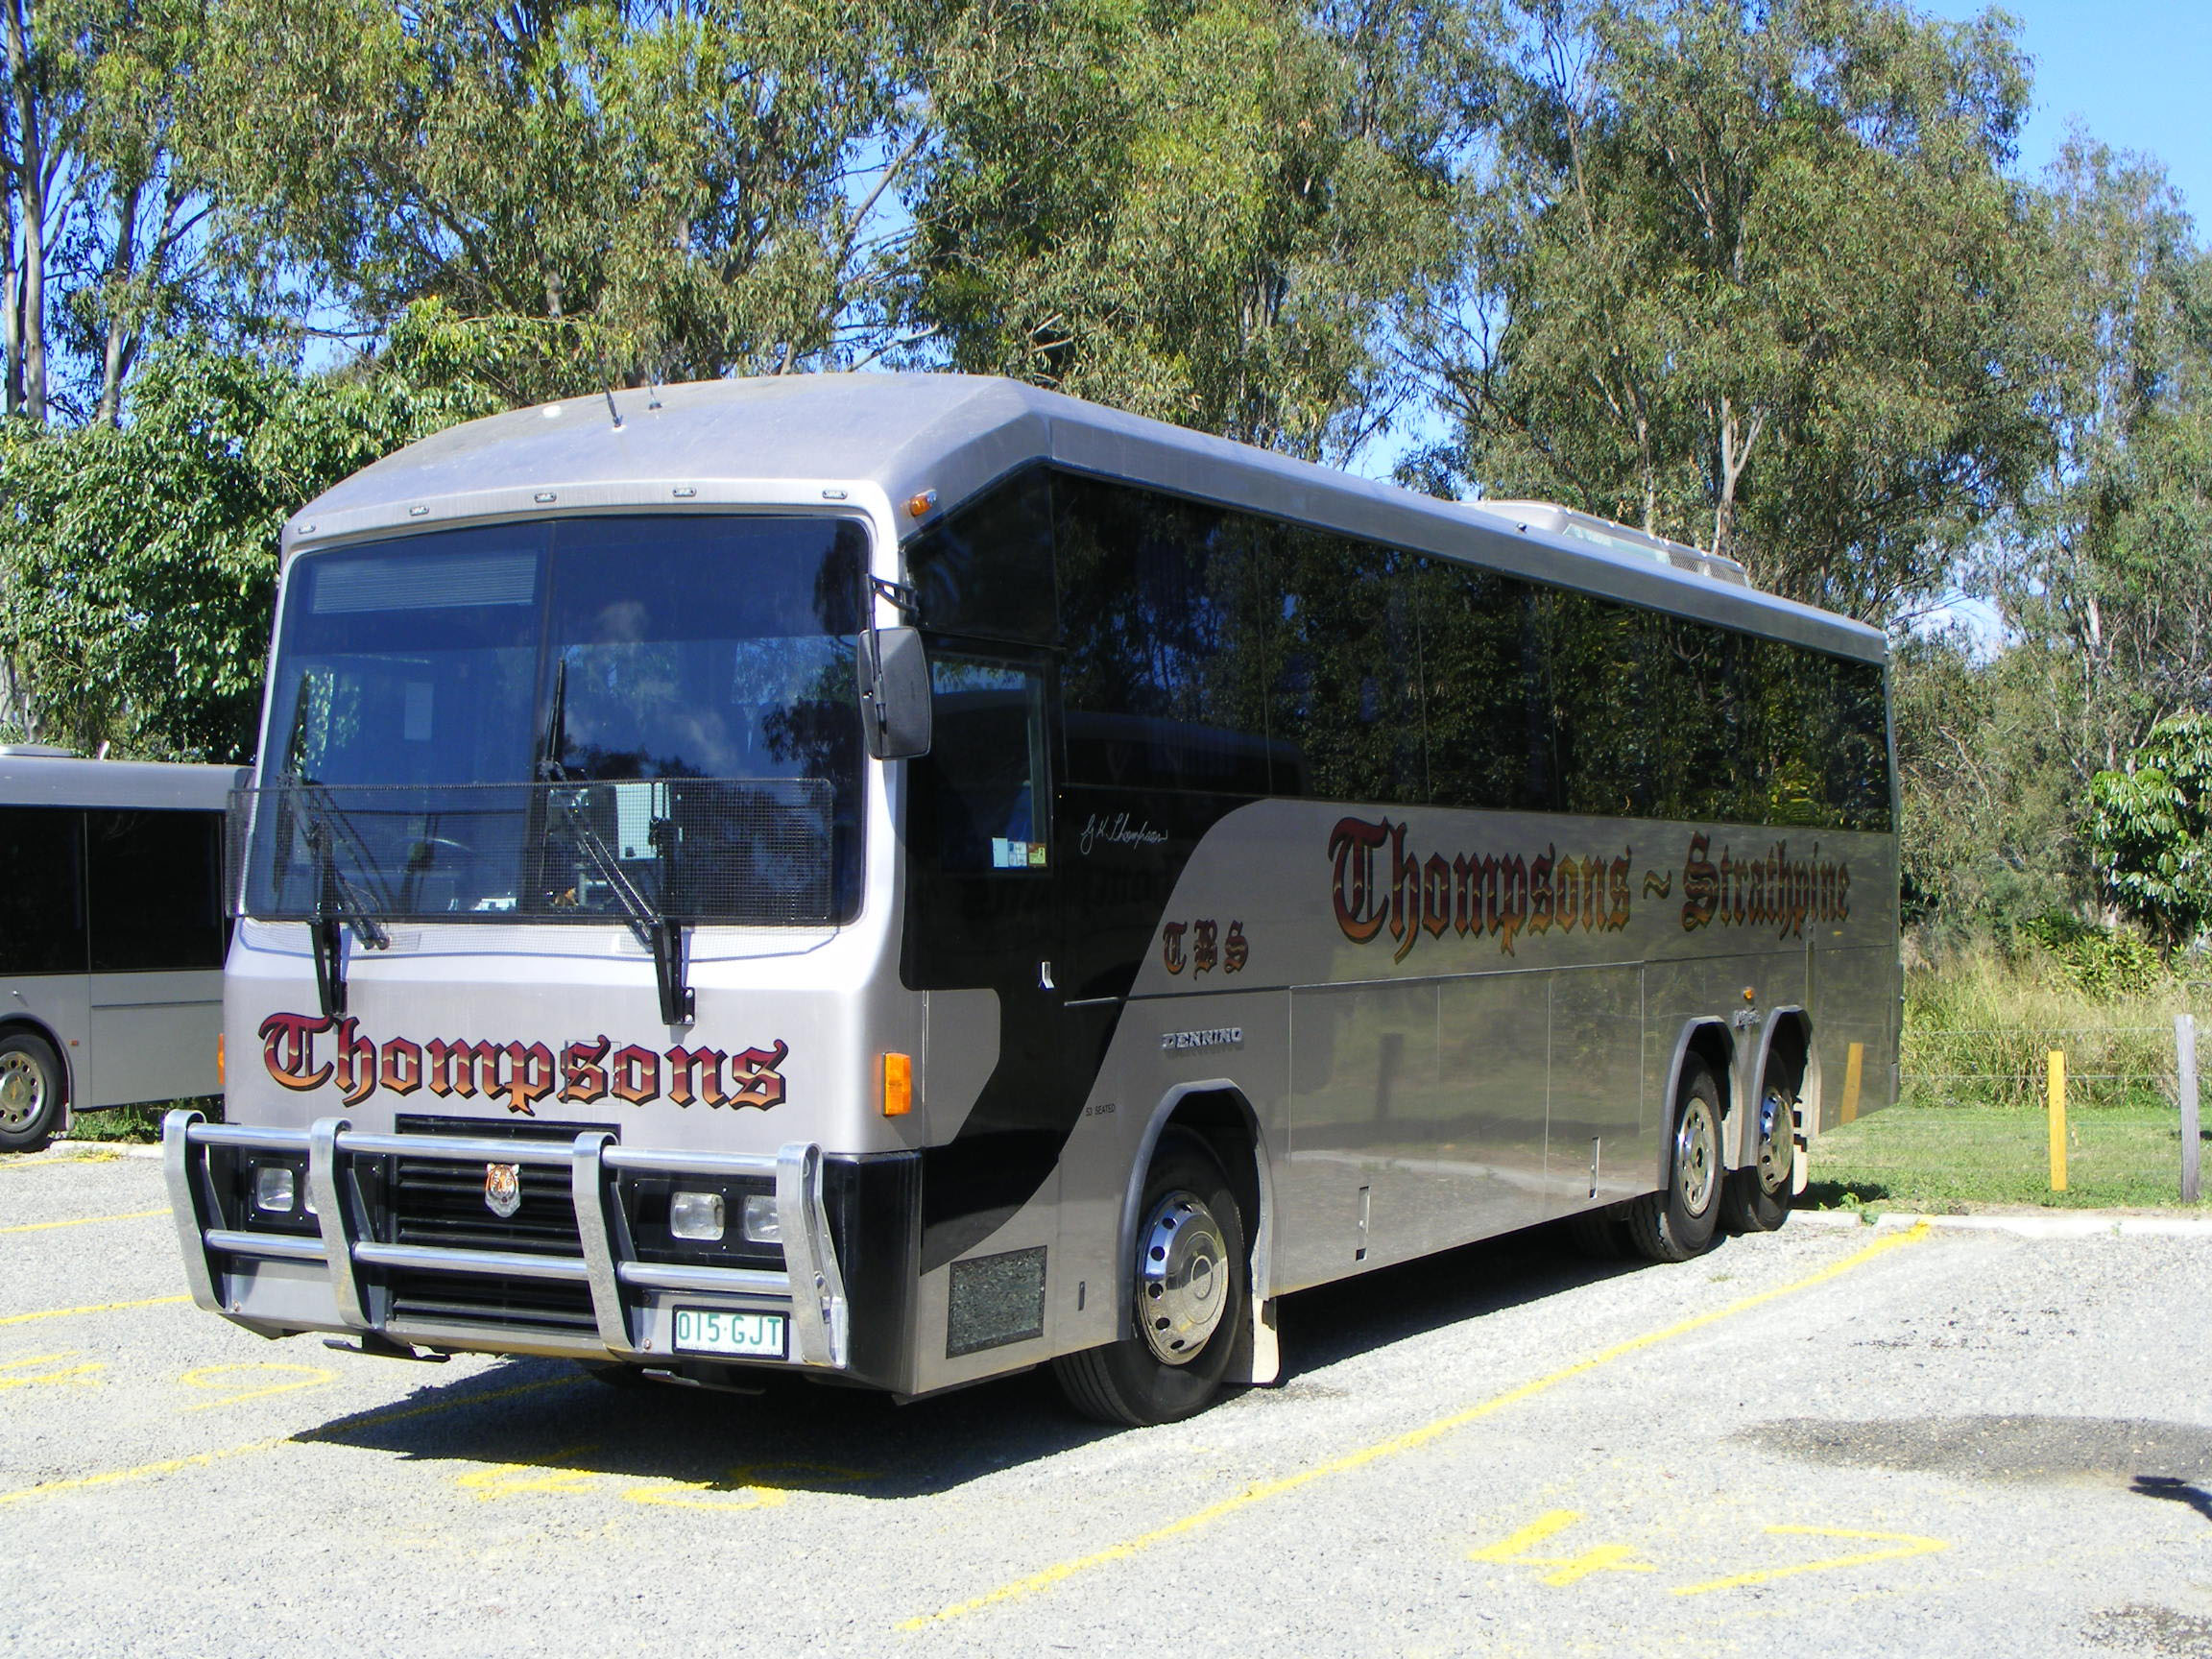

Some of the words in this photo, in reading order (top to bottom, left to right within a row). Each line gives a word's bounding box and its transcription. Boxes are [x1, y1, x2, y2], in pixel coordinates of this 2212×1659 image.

[1328, 816, 1632, 965] Thompsons
[1681, 830, 1851, 941] Strathpine
[258, 1012, 789, 1116] Thompsons
